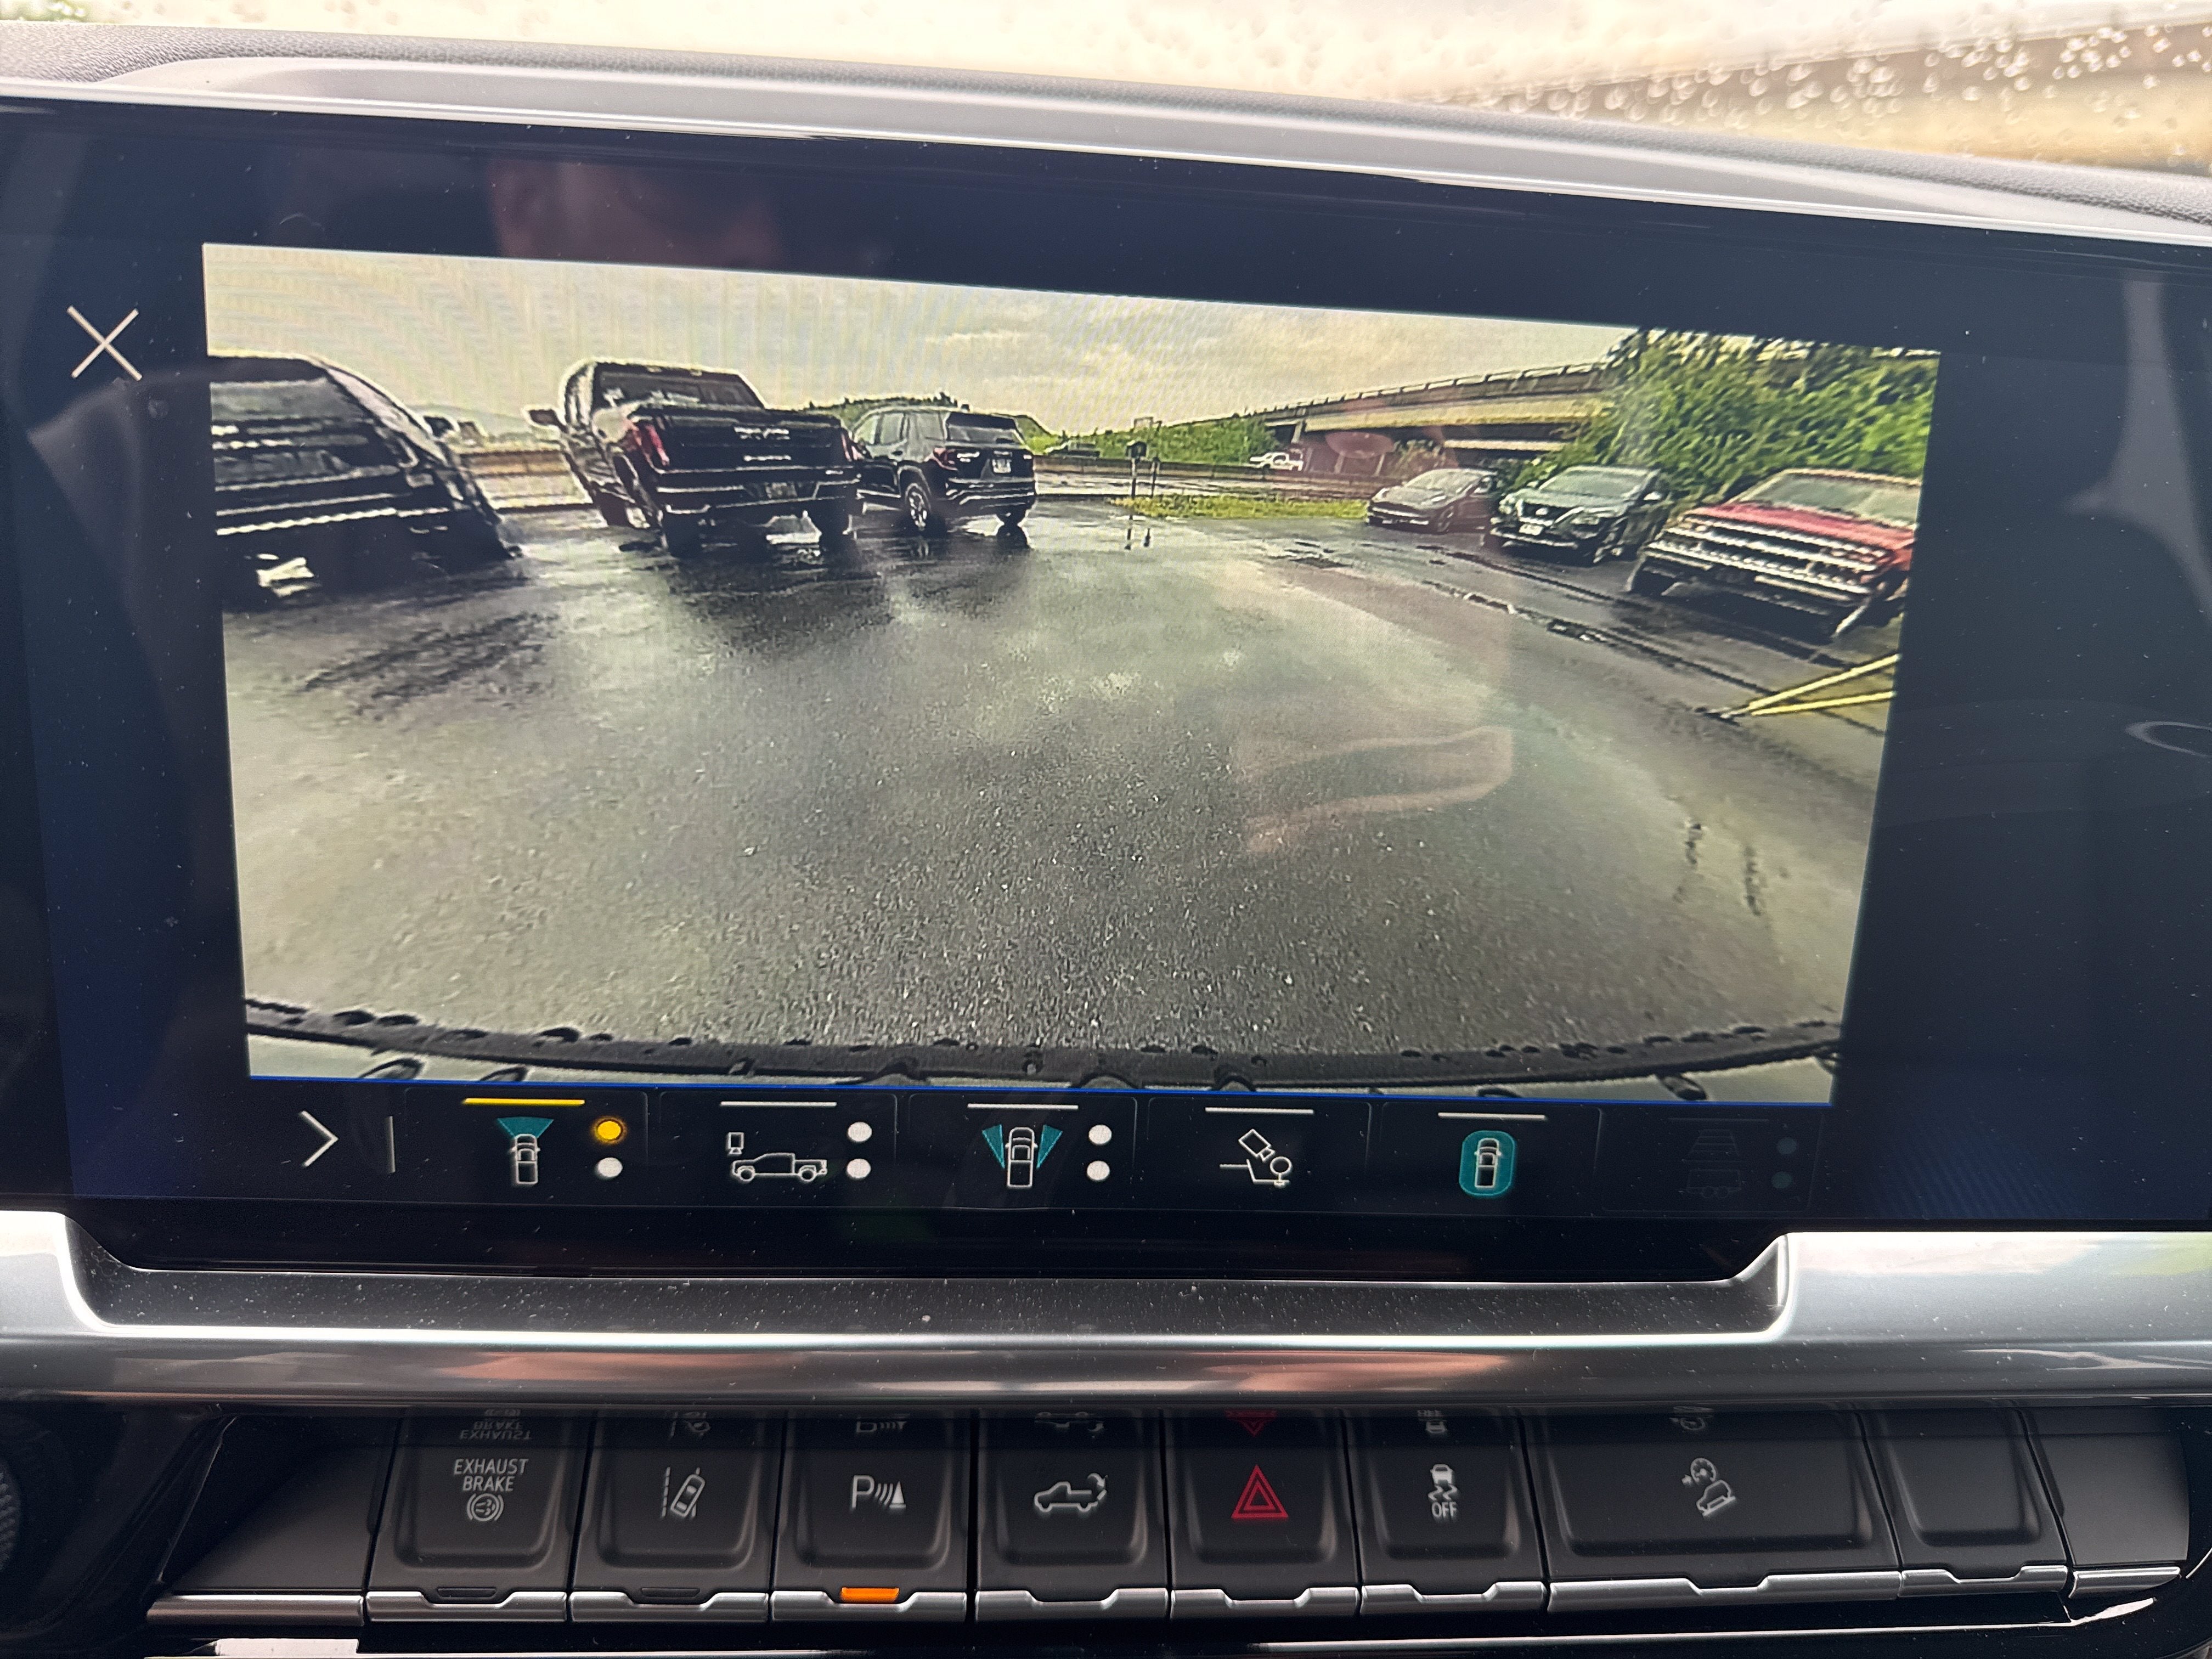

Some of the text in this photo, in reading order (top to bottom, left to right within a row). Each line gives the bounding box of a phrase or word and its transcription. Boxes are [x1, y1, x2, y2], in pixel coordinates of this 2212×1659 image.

[454, 1458, 529, 1475] EXHAUST
[462, 1475, 515, 1491] BRAKE
[852, 1475, 875, 1509] P
[1431, 1501, 1457, 1519] OFF
